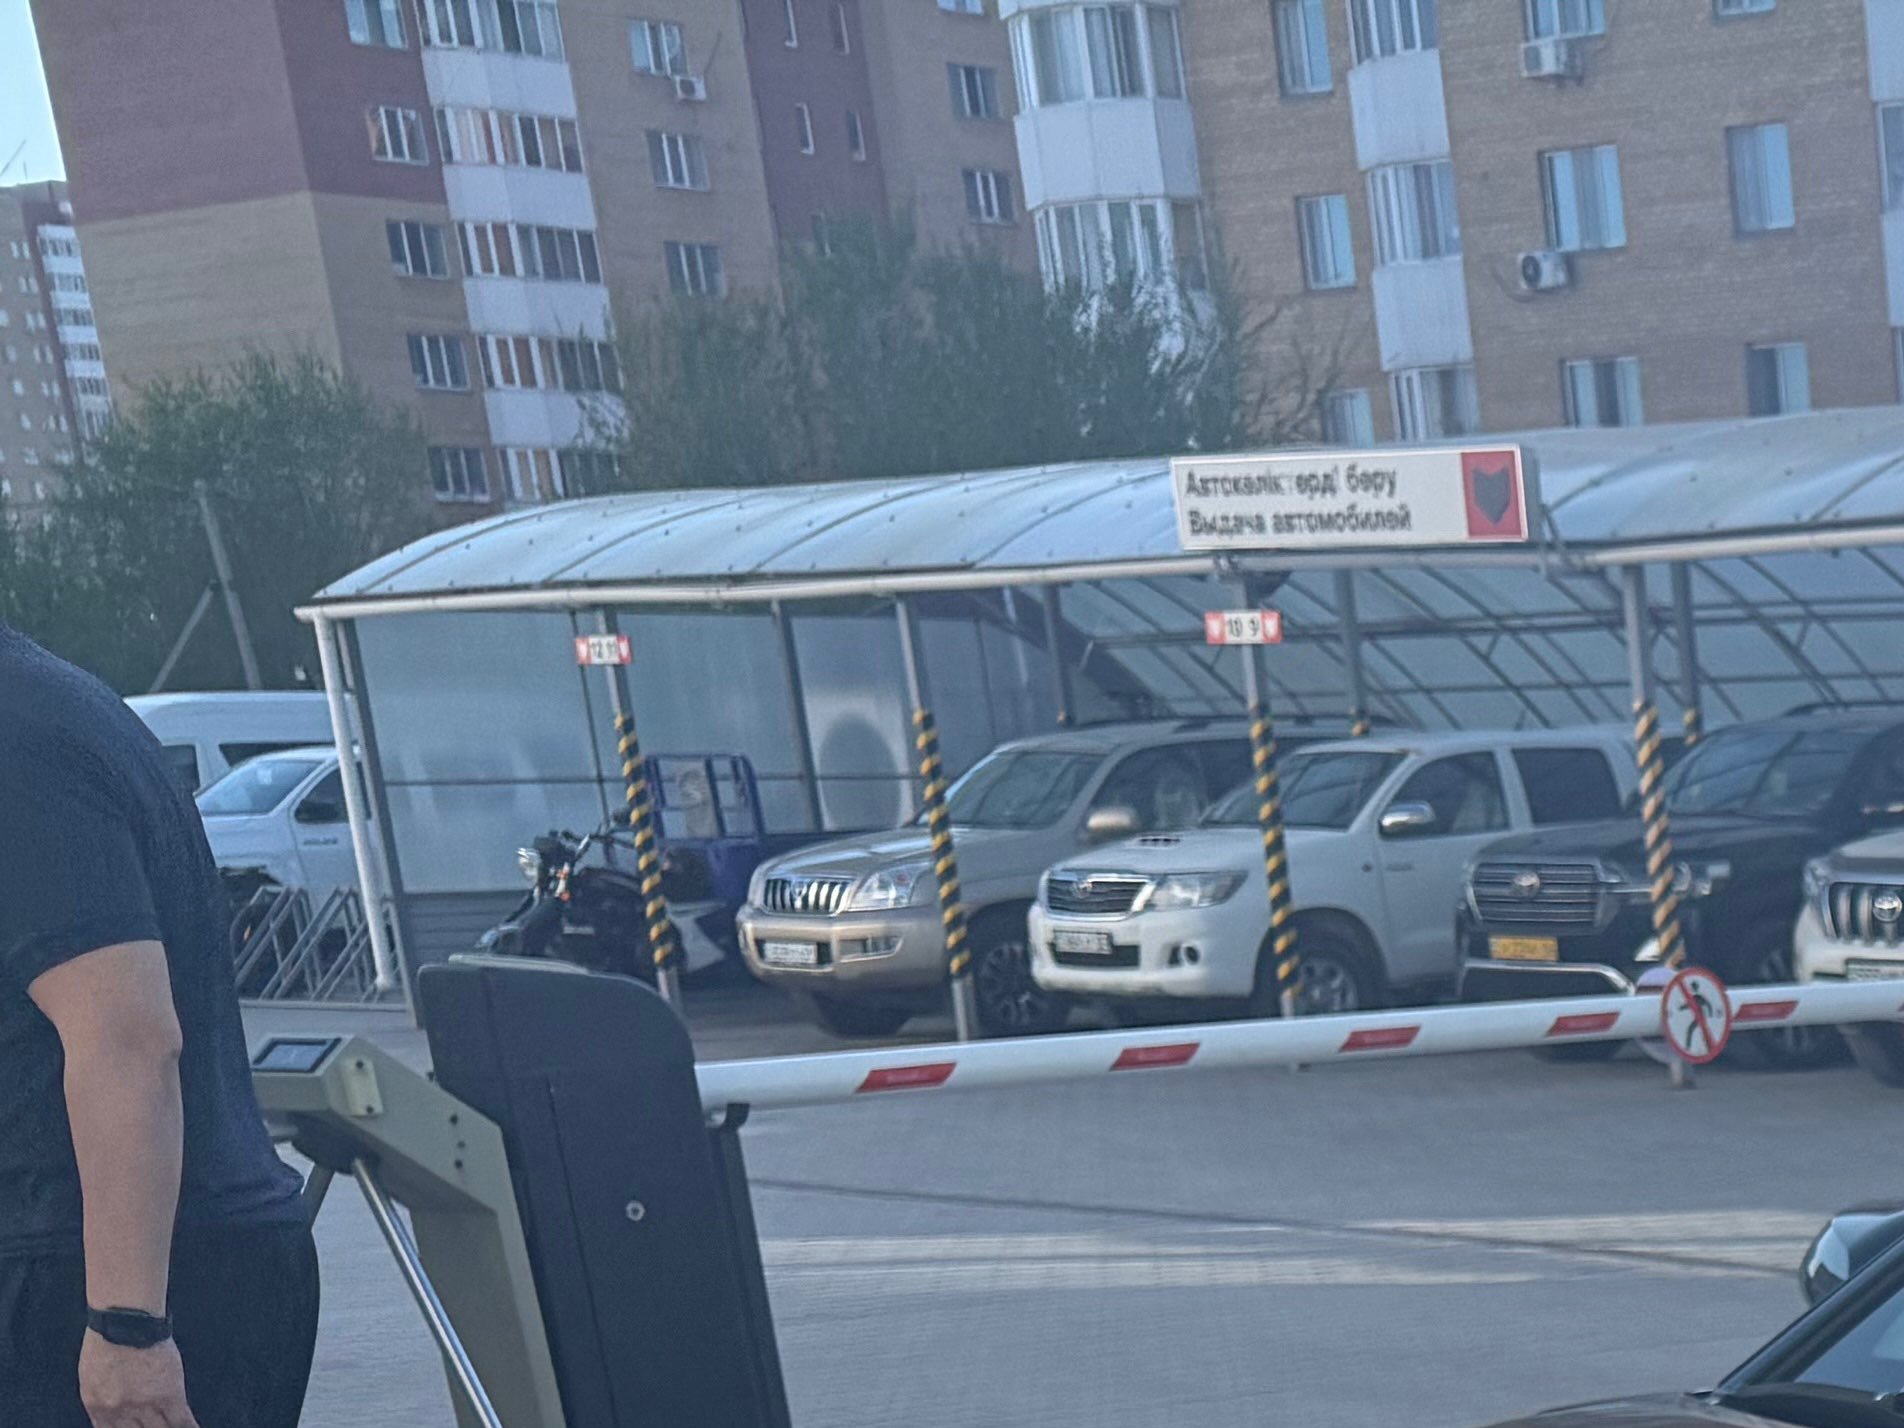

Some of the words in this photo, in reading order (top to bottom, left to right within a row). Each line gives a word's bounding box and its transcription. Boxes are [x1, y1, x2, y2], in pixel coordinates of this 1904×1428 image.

[1346, 463, 1397, 498] беру
[1189, 510, 1266, 539] Выдача
[1272, 504, 1411, 534] автомобилей
